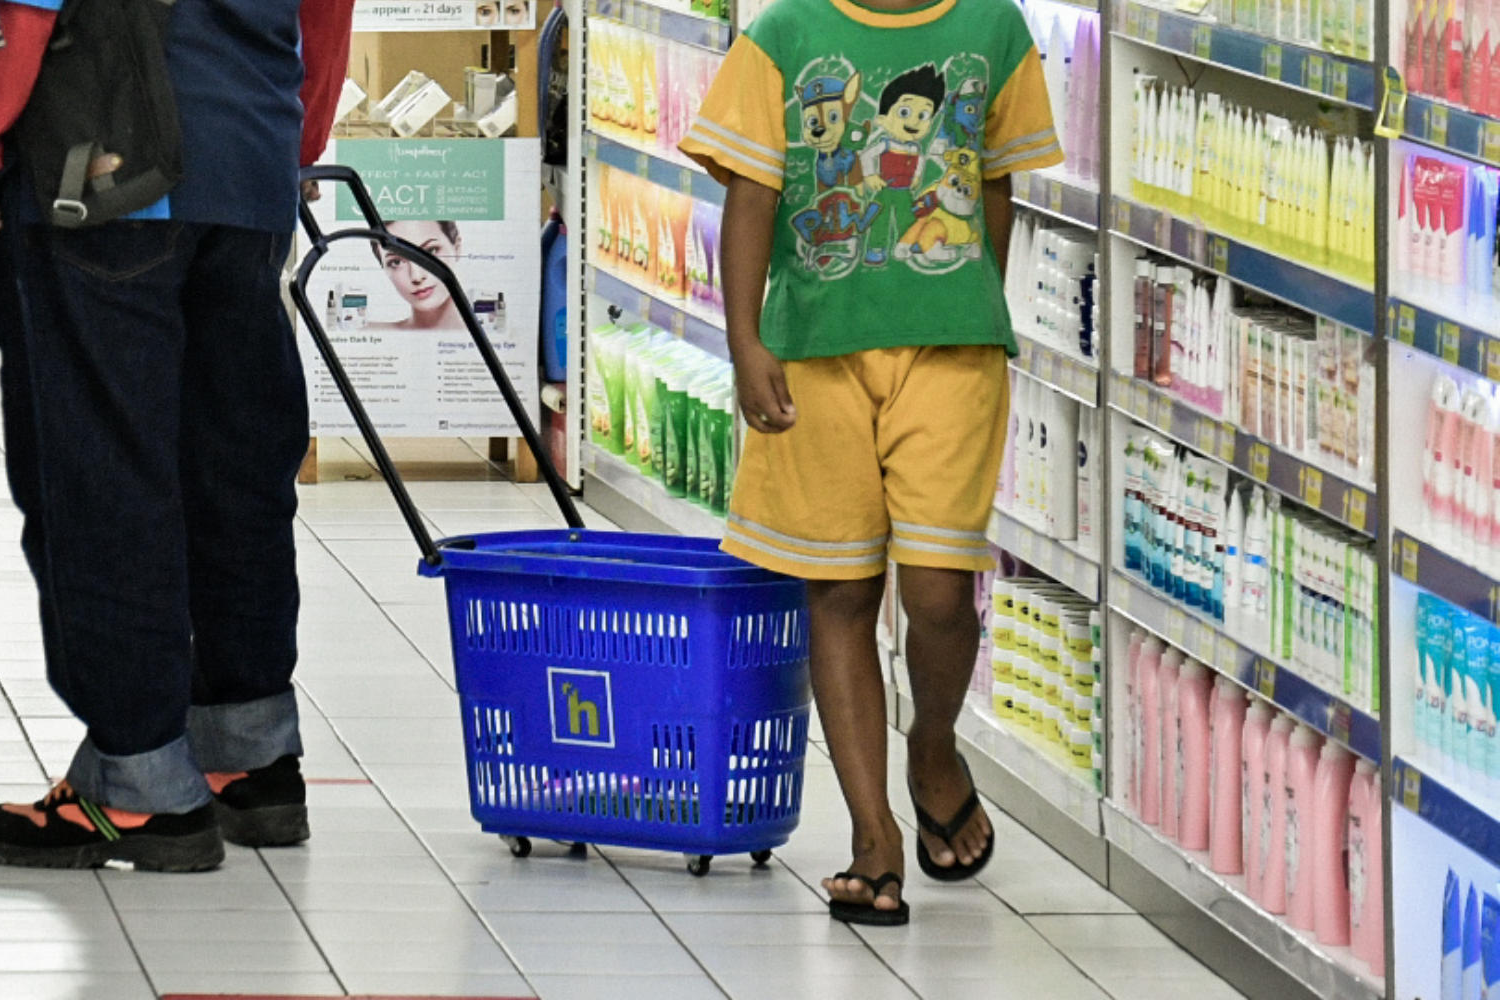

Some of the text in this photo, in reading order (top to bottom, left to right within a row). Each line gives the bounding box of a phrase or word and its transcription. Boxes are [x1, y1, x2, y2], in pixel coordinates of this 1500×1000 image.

[372, 5, 411, 16] appear
[422, 4, 435, 14] 21
[436, 3, 462, 16] days
[357, 169, 398, 179] FFECT
[416, 169, 447, 179] FAST
[377, 184, 430, 205] ACT
[791, 199, 882, 243] PAW
